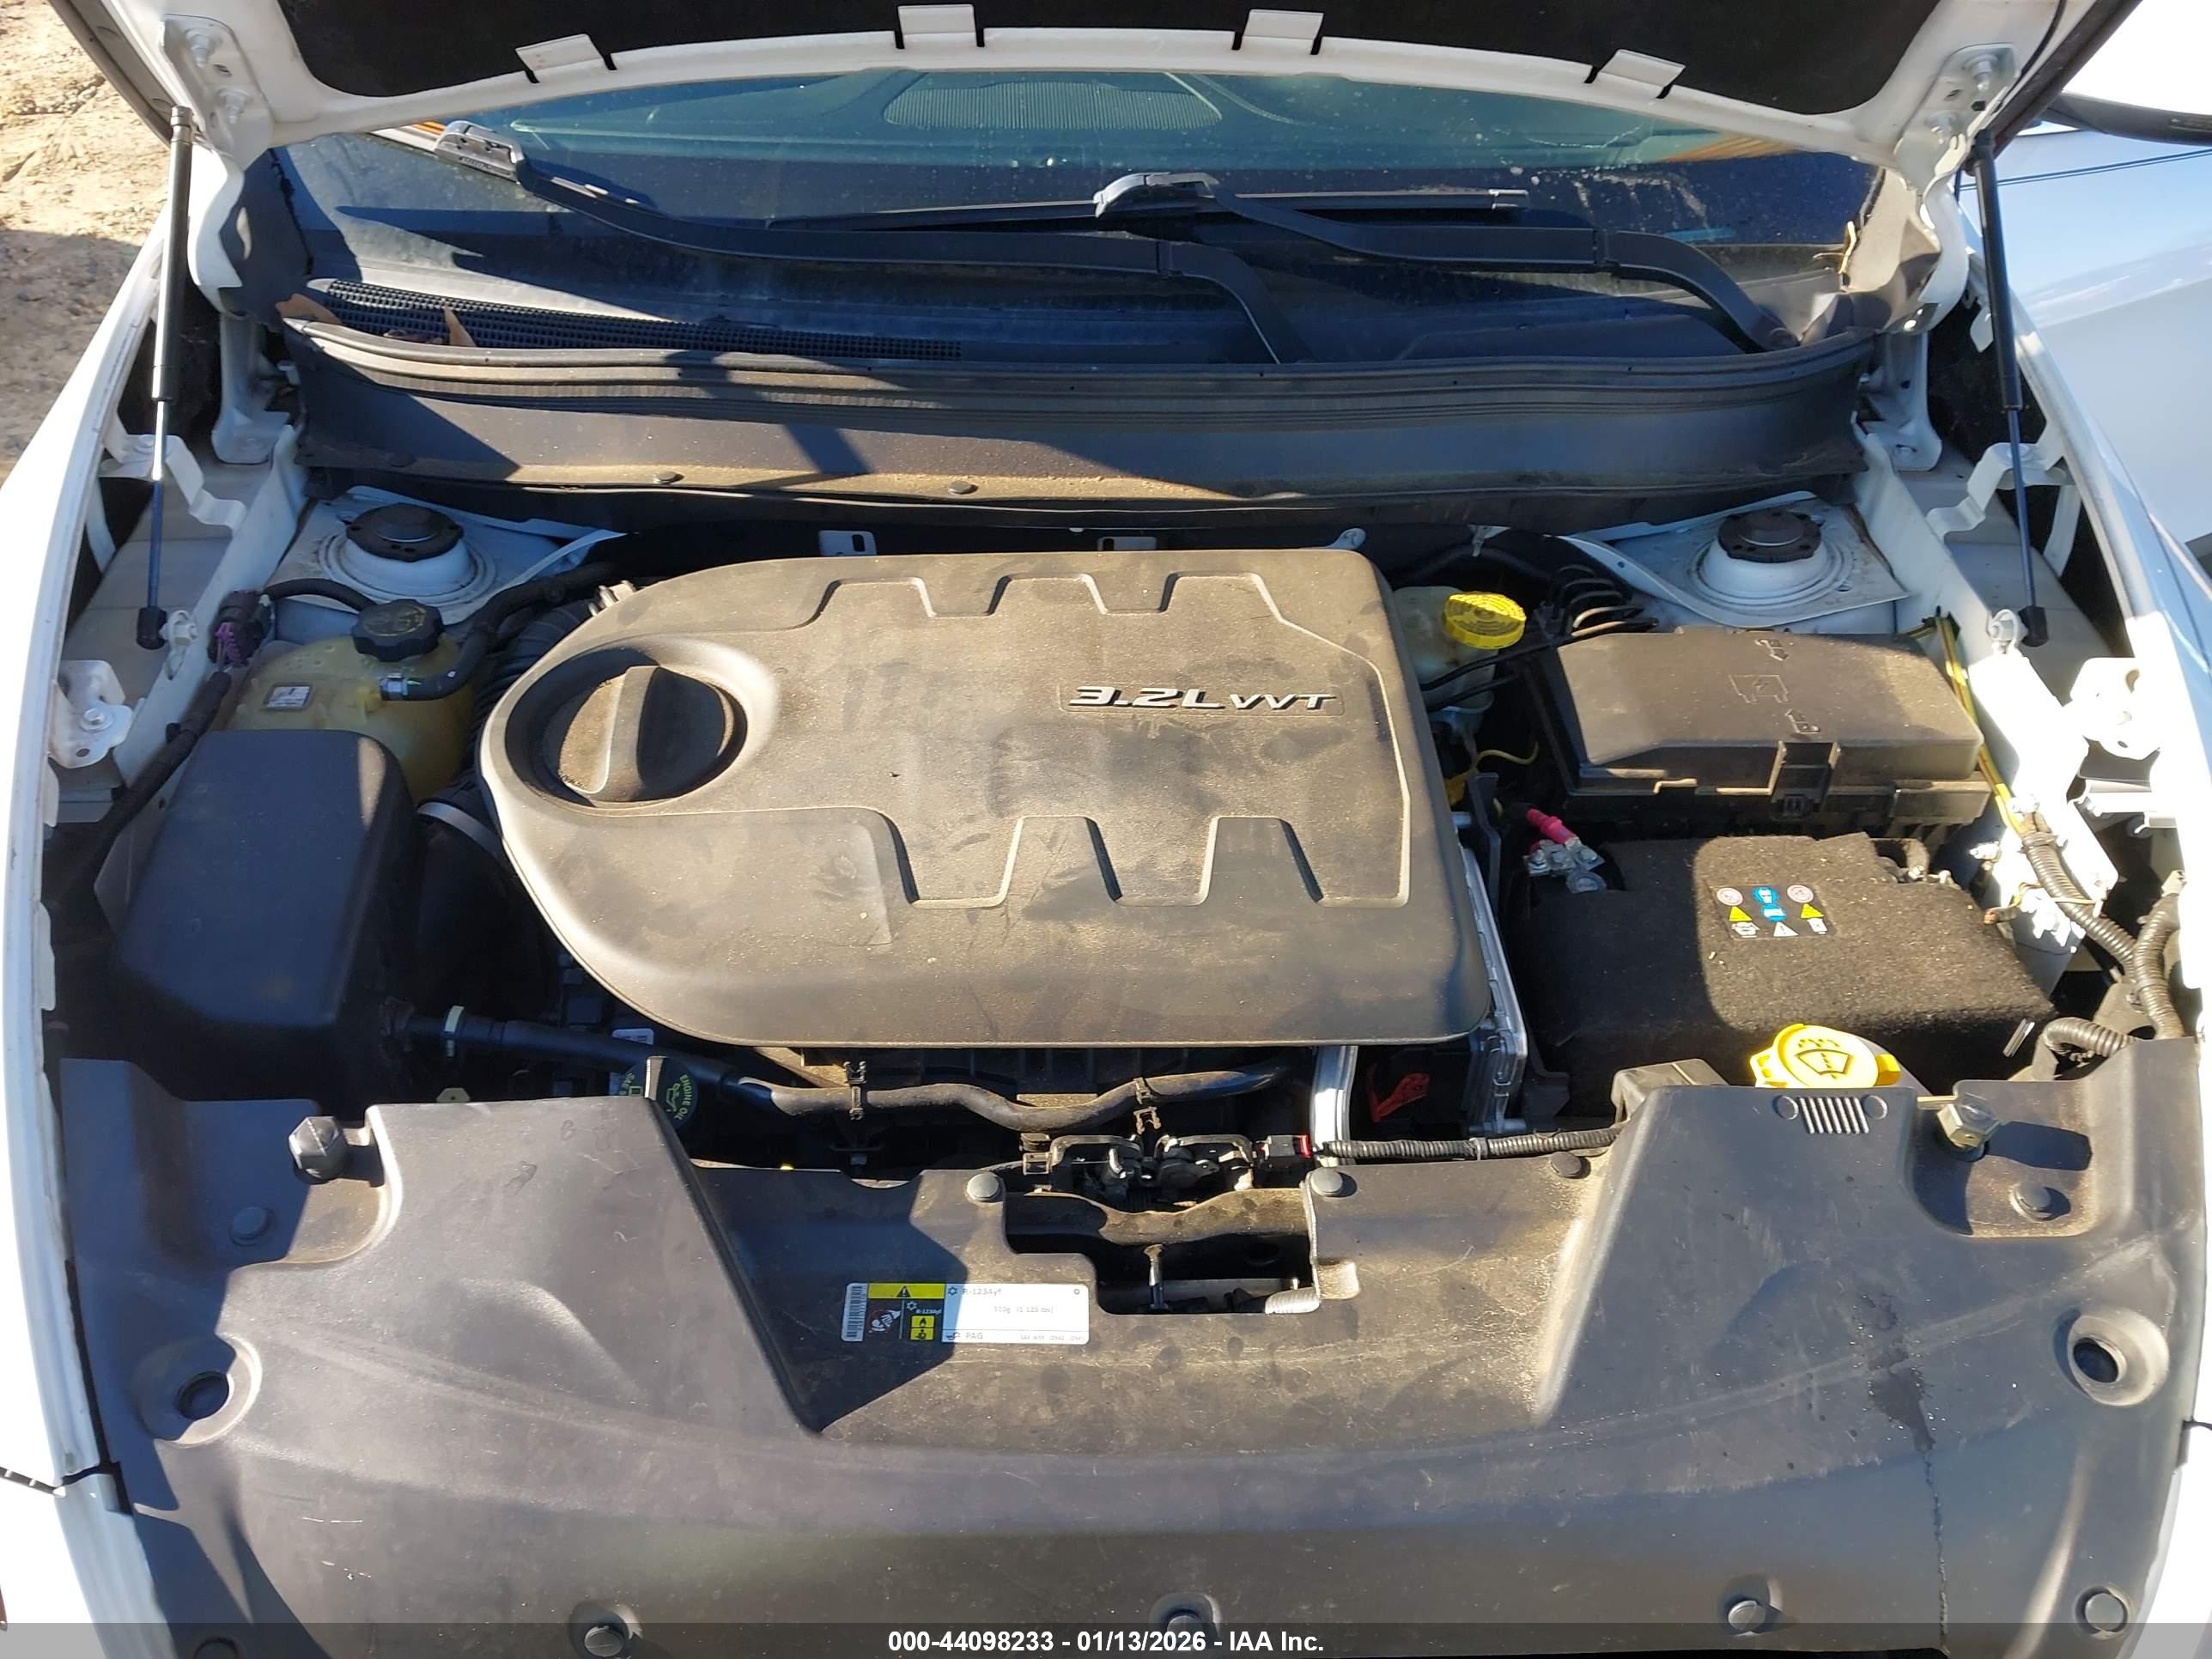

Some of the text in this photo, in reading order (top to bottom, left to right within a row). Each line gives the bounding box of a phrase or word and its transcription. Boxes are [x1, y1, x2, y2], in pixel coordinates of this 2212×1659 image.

[1068, 685, 1337, 710] 3.2L VVT
[673, 1073, 693, 1121] ENGINE OIL
[965, 1331, 984, 1340] PAG
